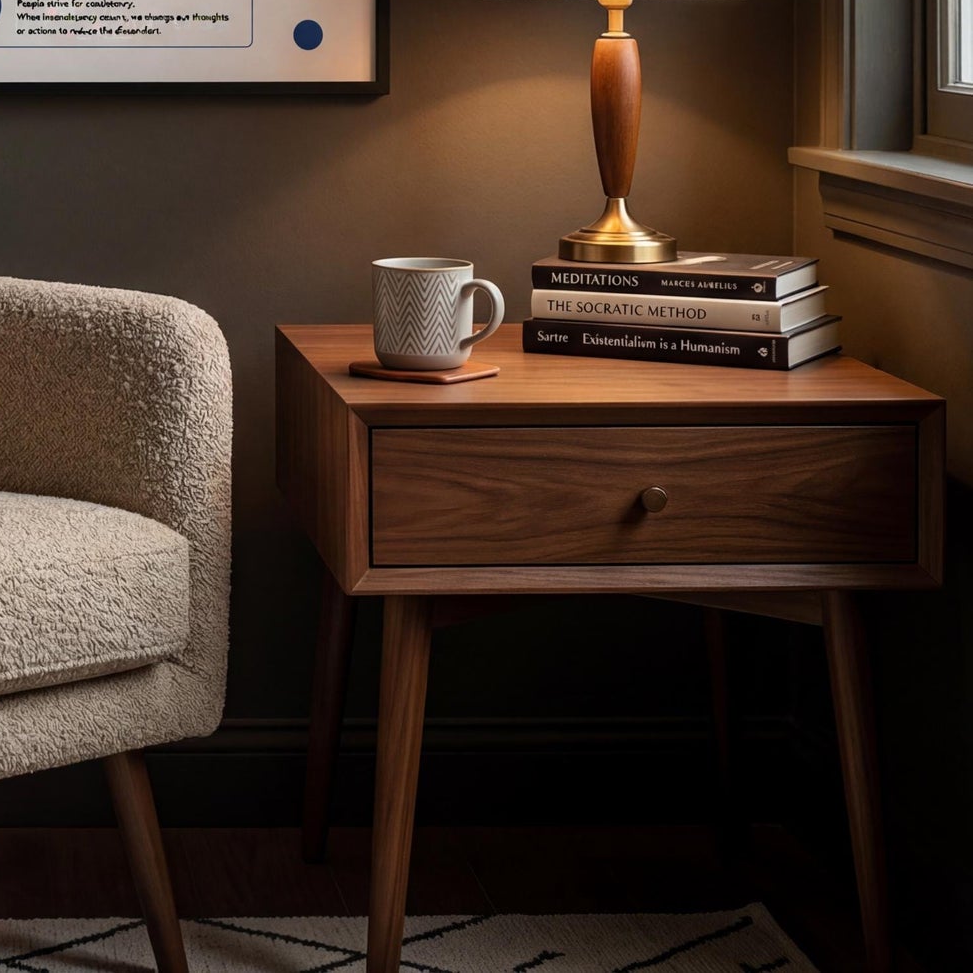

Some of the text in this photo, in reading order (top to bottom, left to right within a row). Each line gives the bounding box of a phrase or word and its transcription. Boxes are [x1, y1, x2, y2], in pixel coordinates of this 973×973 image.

[59, 27, 68, 35] to
[551, 272, 639, 287] MEDITATIONS
[547, 299, 707, 320] THE SOCRATIC METHOD
[537, 330, 569, 343] Sartre
[659, 338, 669, 350] is
[671, 342, 677, 350] a
[680, 340, 740, 355] Humanism
